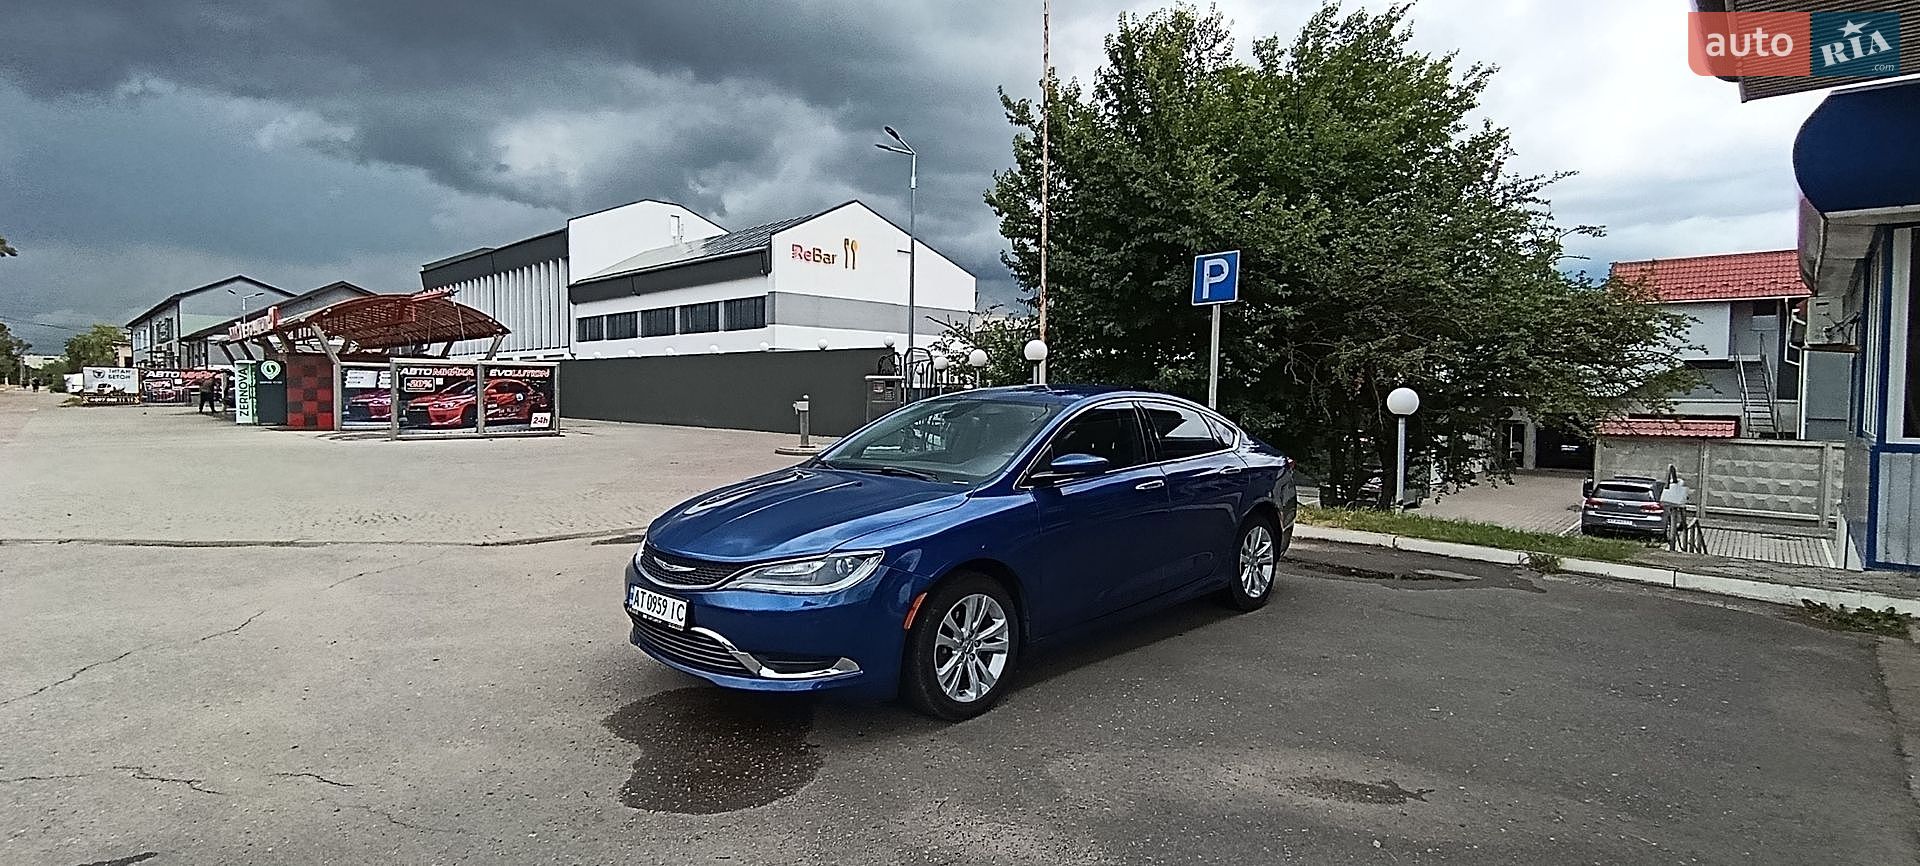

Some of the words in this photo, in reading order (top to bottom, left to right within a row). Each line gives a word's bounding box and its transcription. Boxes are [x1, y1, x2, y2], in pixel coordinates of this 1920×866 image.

[791, 243, 837, 264] ReBar
[1202, 258, 1229, 299] P
[489, 368, 550, 378] EVOLUTION
[239, 367, 250, 417] ZERNOVA
[532, 416, 548, 424] 24h
[633, 589, 647, 608] AT
[646, 593, 668, 616] 0959
[670, 601, 685, 622] IC
